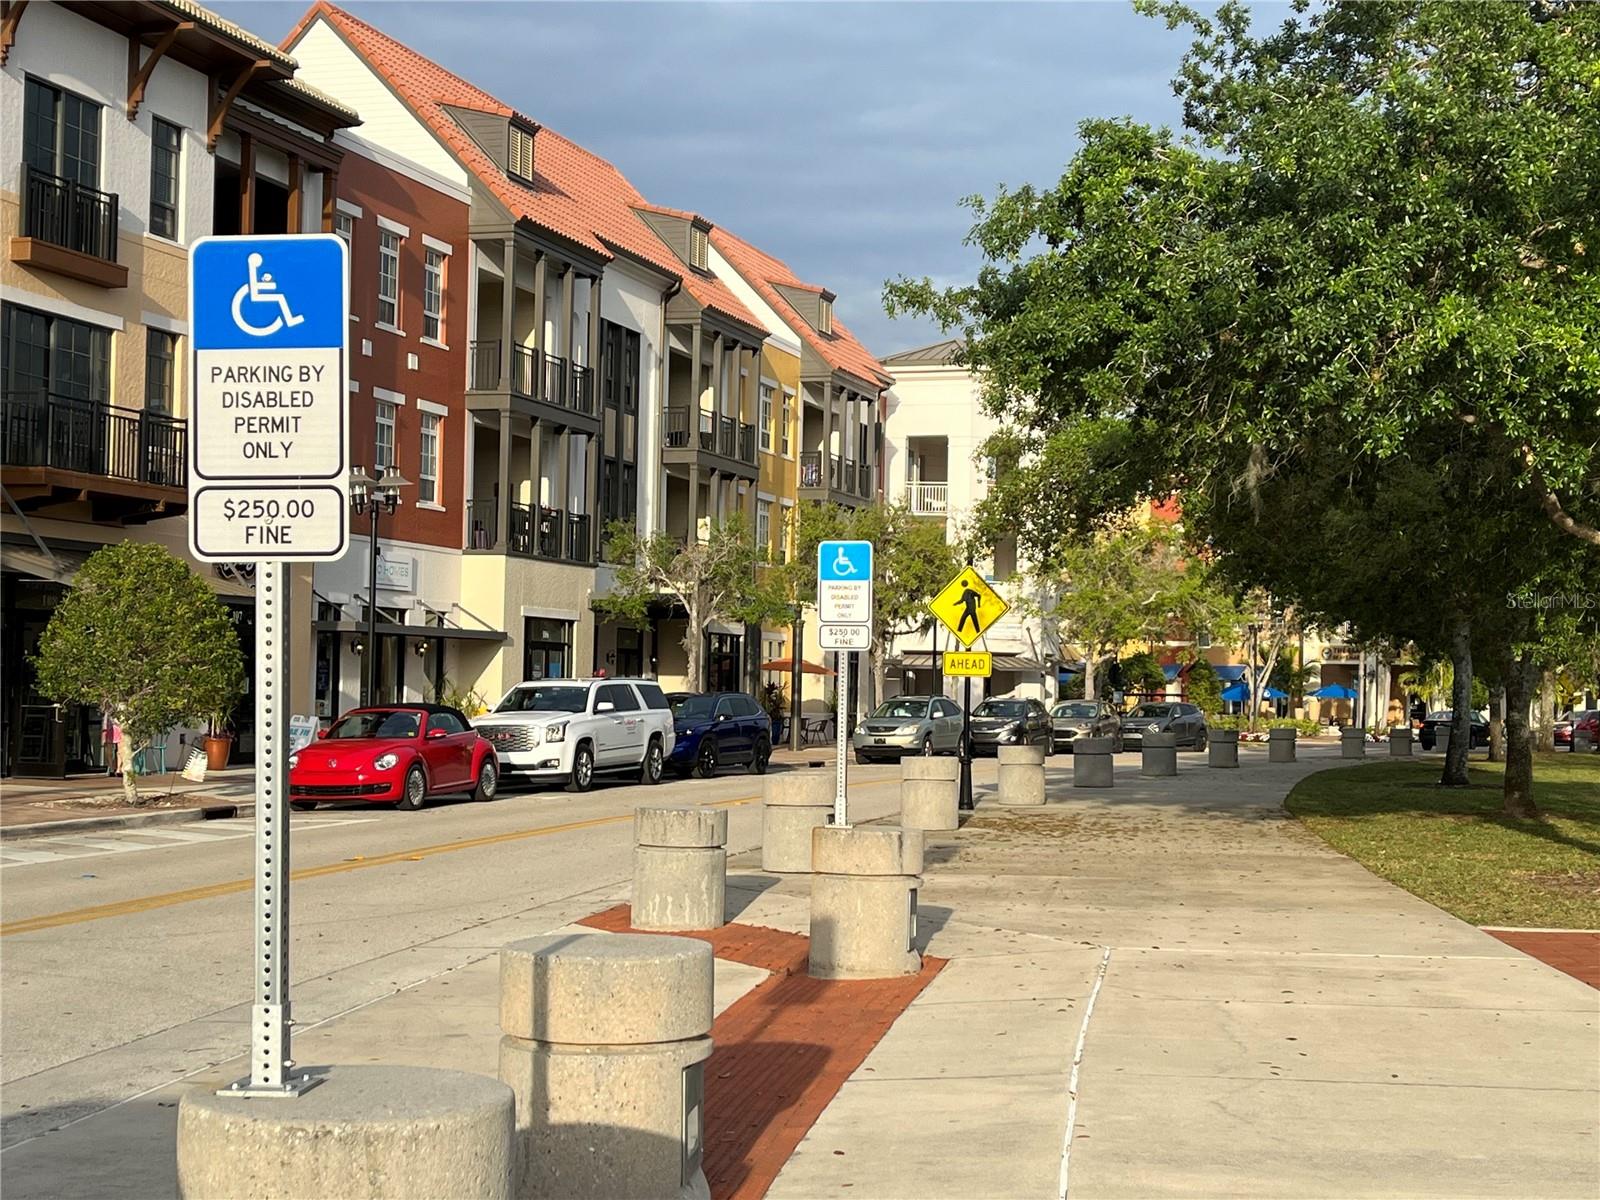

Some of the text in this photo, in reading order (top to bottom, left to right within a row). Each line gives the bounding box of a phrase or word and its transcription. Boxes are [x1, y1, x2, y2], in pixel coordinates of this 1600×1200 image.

[211, 364, 326, 384] PARKING BY
[222, 390, 314, 409] DISABLED
[234, 416, 302, 434] PERMIT
[243, 441, 294, 459] ONLY
[223, 498, 315, 521] $250.00
[245, 526, 293, 544] FINE
[828, 628, 861, 637] $25000
[834, 638, 855, 646] FINE
[950, 658, 985, 670] AHEAD
